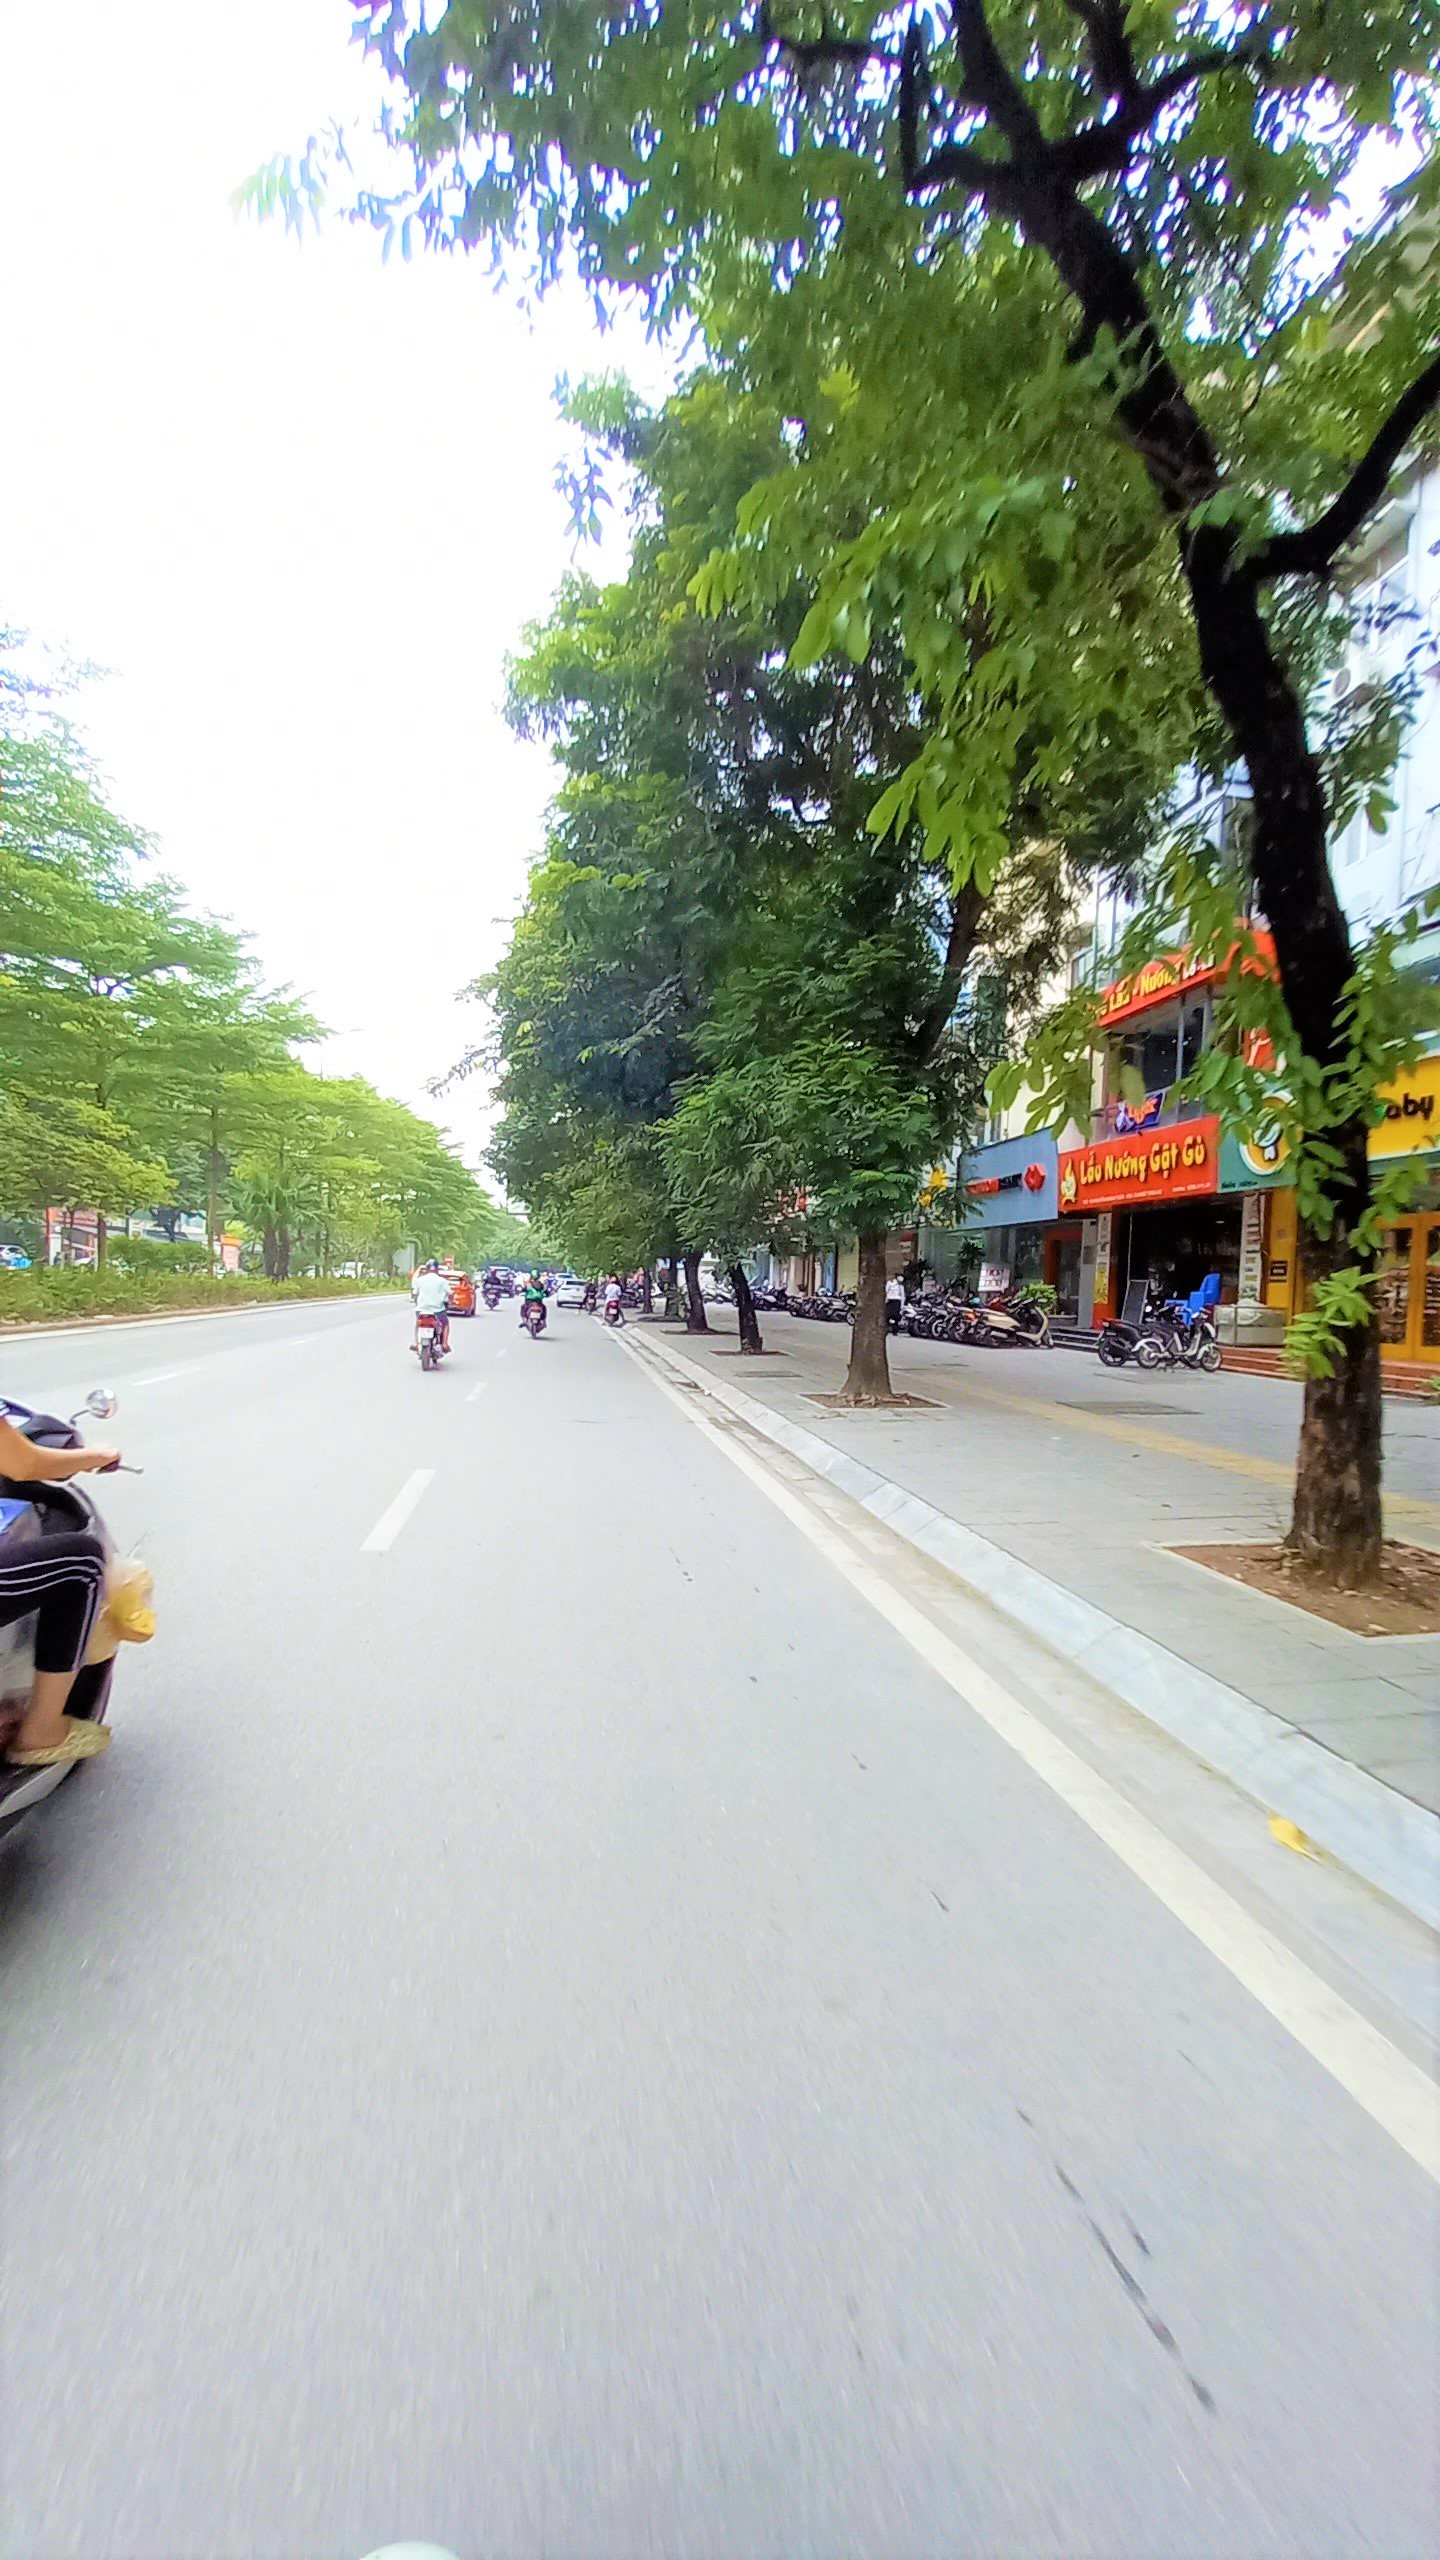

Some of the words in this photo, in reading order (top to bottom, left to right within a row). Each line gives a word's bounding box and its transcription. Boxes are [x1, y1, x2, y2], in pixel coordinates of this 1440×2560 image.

[1376, 1092, 1435, 1121] aby
[1104, 1150, 1147, 1183] Nướng
[1150, 1142, 1179, 1180] Gật
[1182, 1134, 1206, 1167] Gù
